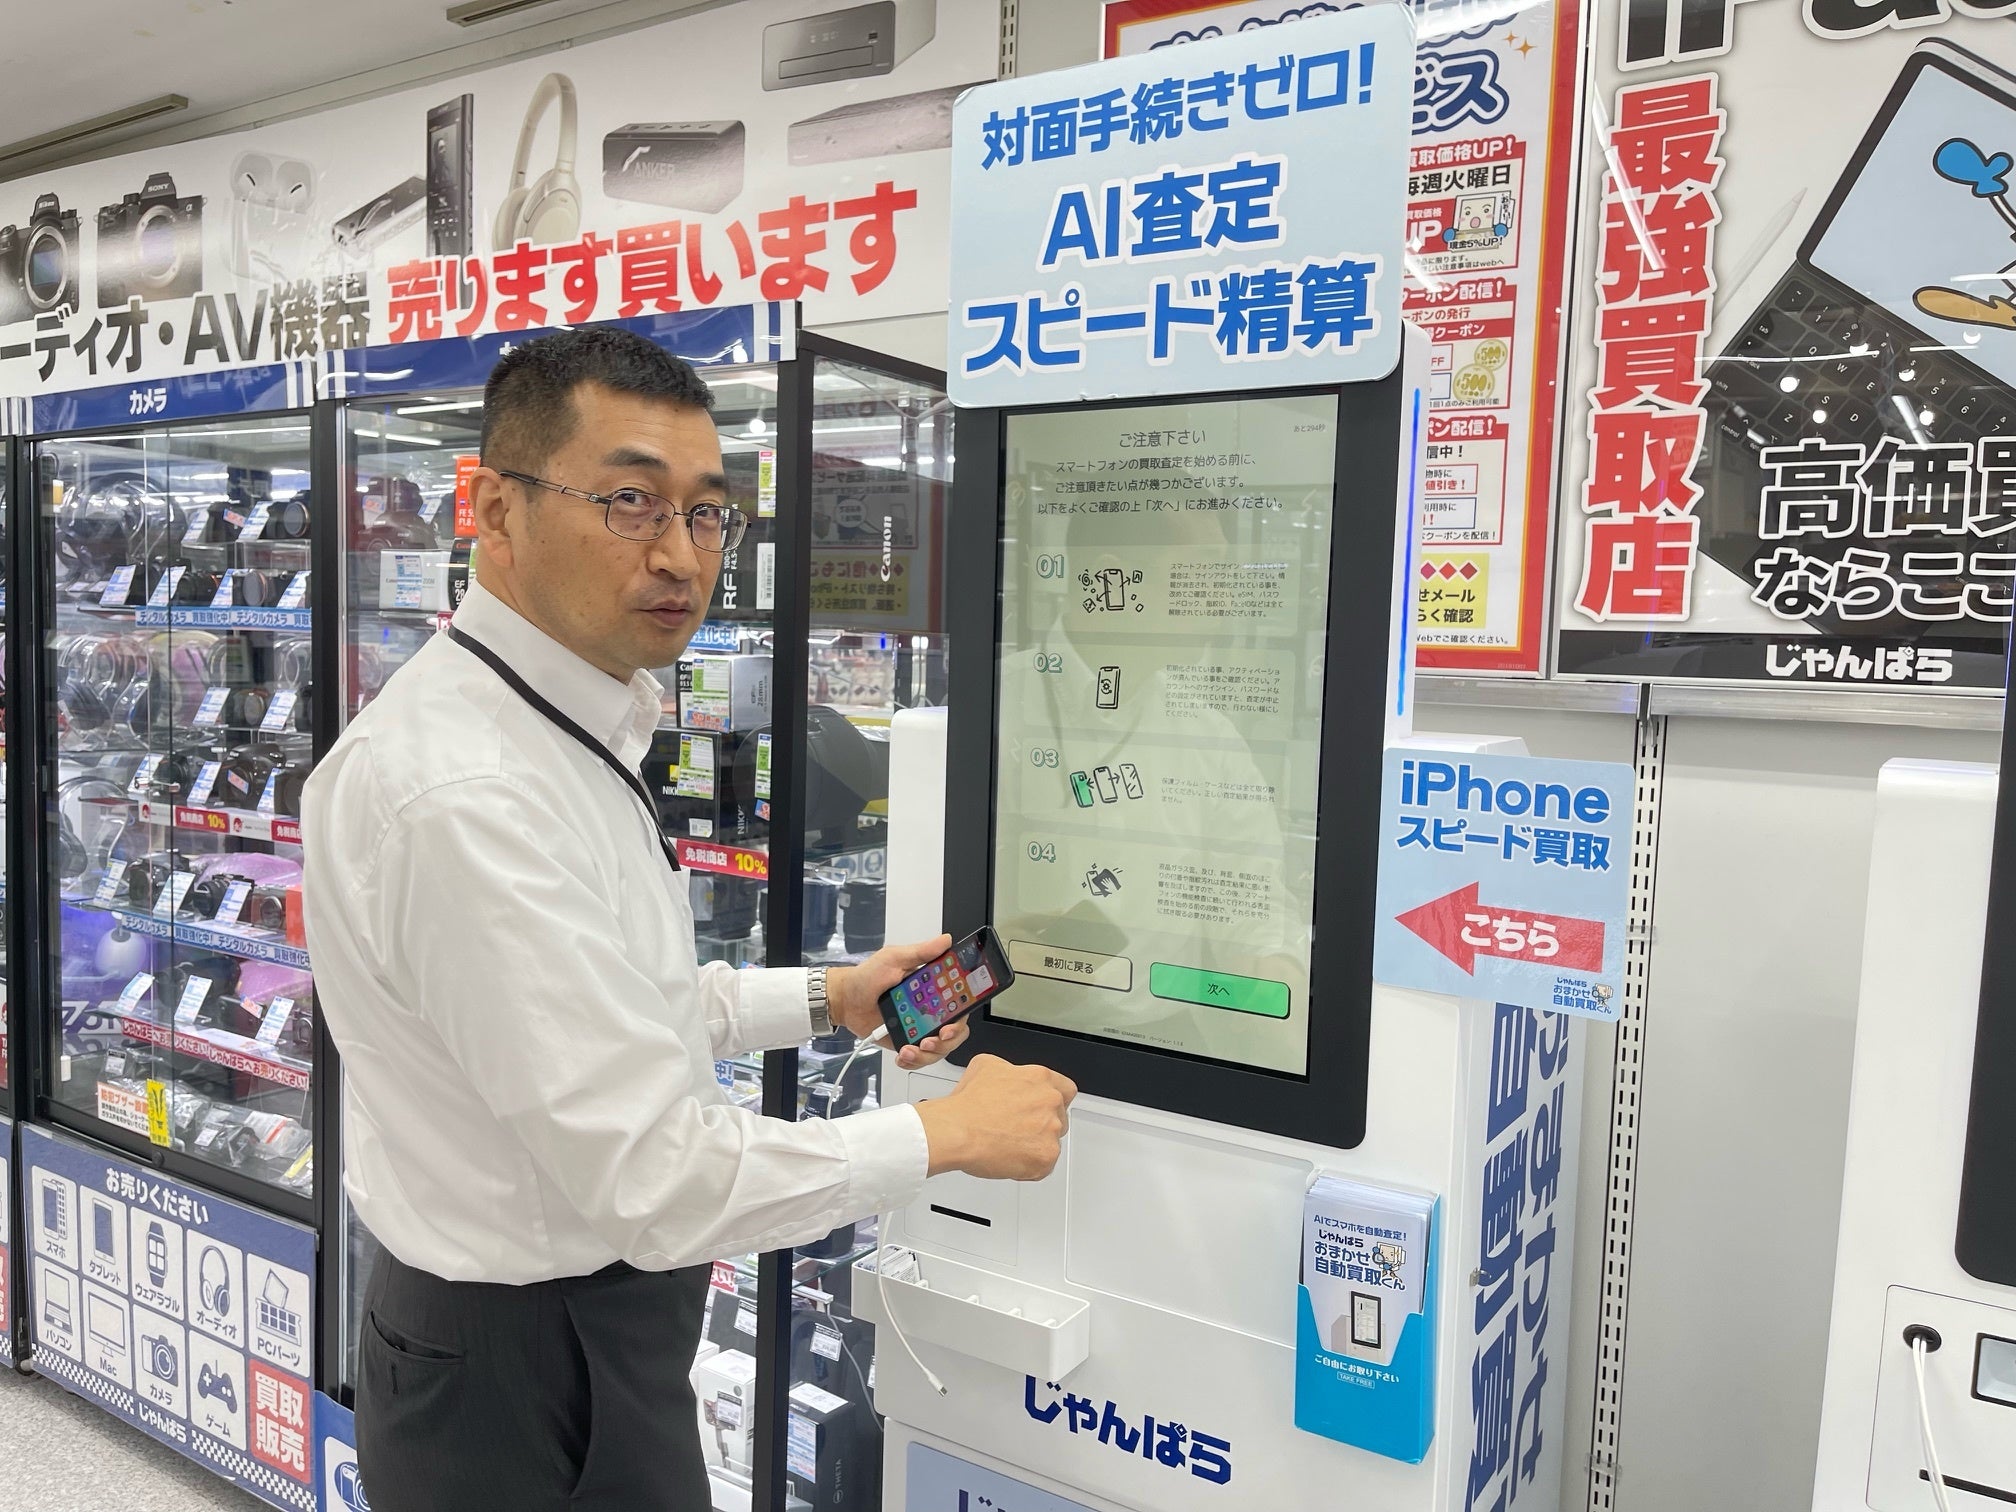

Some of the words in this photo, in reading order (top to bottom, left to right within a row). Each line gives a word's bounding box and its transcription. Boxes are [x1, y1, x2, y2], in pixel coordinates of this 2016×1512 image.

[981, 42, 1376, 171] 対面手続きゼロ！
[1042, 159, 1282, 266] AI査定
[387, 180, 918, 344] 売ります買います
[1415, 254, 1468, 266] 品に限ります。
[1420, 258, 1504, 272] しい注意事項はwebへ
[966, 260, 1376, 372] スピード精算
[1578, 77, 1723, 621] 最強買取店
[129, 387, 167, 416] カメラ
[1119, 429, 1206, 448] ご注意下さい
[1293, 423, 1326, 433] あと294秒
[1056, 453, 1256, 473] スマートフォンの買取査定を始める前に、
[1055, 476, 1245, 494] ご注意頂きたい点が幾つかございます。
[1037, 496, 1284, 515] 以下をよくご確認の上「次へ」にお進みください。
[881, 516, 892, 582] Canon
[1036, 554, 1064, 578] 01
[722, 574, 737, 610] RF
[1751, 547, 2015, 622] ならここ
[1033, 652, 1063, 674] 02
[1765, 644, 1953, 682] じゃんぱら
[1030, 747, 1059, 768] 03
[1401, 760, 1610, 824] iPhone
[207, 814, 226, 830] 10%
[1027, 841, 1056, 863] 04
[1396, 816, 1610, 871] スピード買取
[735, 853, 767, 874] 10%
[1460, 913, 1560, 957] こちら
[1044, 956, 1094, 975] 最初に戻る
[1207, 983, 1230, 996] 次へ
[1553, 984, 1591, 999] おまかせ
[106, 1167, 209, 1225] お売りください
[1313, 1214, 1407, 1242] AIでスマホを自動査定！
[1318, 1229, 1364, 1248] じゃんぱら
[46, 1240, 66, 1259] スマホ
[1314, 1240, 1371, 1267] おまかせ
[1465, 1002, 1536, 1512] 自動買
[89, 1260, 121, 1286] タブレット
[1315, 1257, 1406, 1291] 自動買取くん
[135, 1283, 180, 1314] ウェアラブル
[196, 1310, 237, 1340] オーディオ
[45, 1328, 73, 1352] パソコン
[257, 1338, 301, 1368] PCパーツ
[99, 1357, 117, 1377] Mac
[1314, 1353, 1400, 1384] ご自由にお取り下さい
[1338, 1372, 1355, 1385] TAKE
[1356, 1377, 1373, 1388] FREE
[149, 1384, 173, 1406] カメラ
[255, 1374, 304, 1430] 買取
[139, 1402, 187, 1444] じゃんぱら
[205, 1414, 231, 1438] ゲーム
[1025, 1374, 1231, 1485] じゃんぱら
[255, 1419, 306, 1473] 販売
